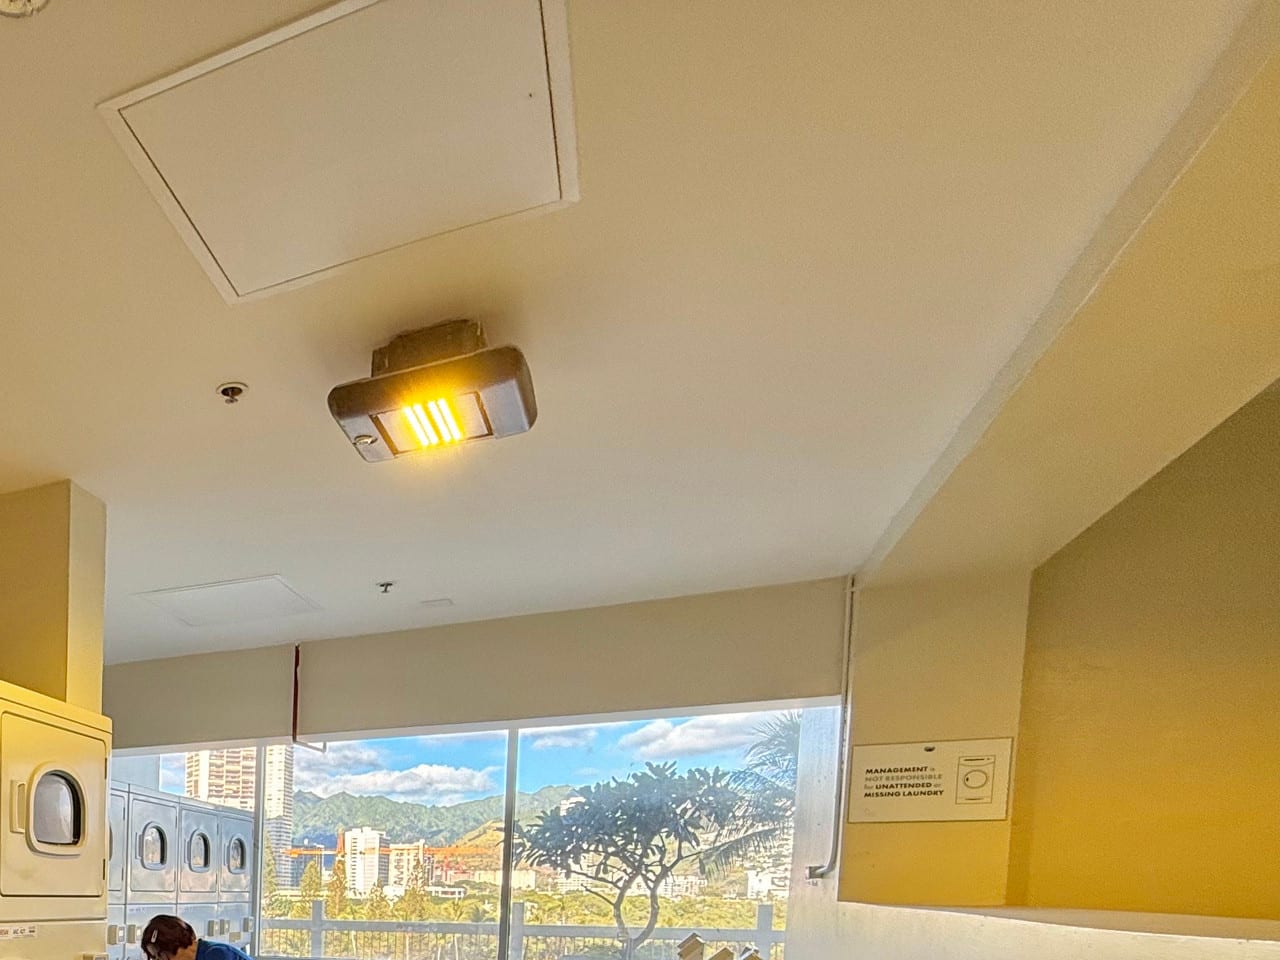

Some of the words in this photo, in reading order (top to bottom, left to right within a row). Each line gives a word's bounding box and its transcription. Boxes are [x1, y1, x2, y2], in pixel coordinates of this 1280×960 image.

[865, 766, 928, 774] MANAGEMENT
[885, 773, 942, 782] RESPONSIBLE
[875, 782, 932, 790] UNATTENDED
[864, 790, 901, 798] MISSING
[903, 789, 944, 797] LAUNDRY
